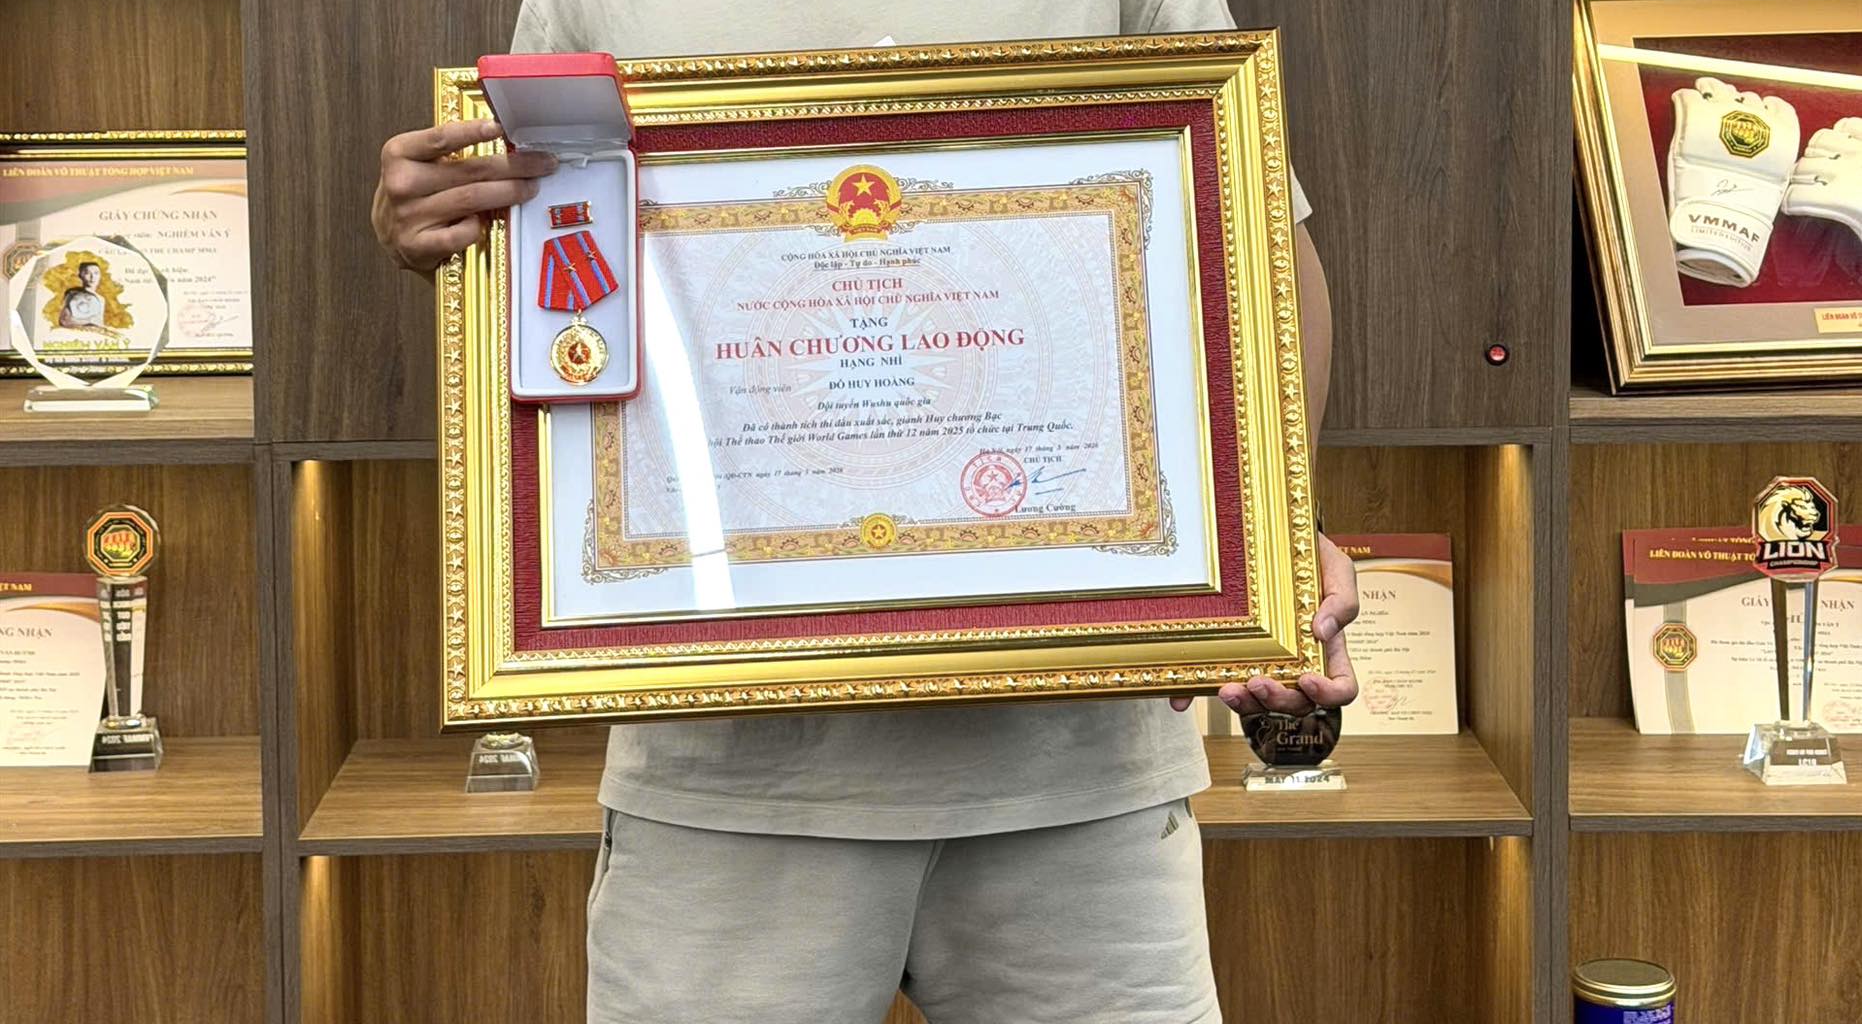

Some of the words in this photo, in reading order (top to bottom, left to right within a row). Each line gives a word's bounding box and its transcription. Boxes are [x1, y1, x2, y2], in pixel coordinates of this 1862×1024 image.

[182, 209, 218, 221] NHẬN
[1688, 214, 1760, 243] VMMAF
[781, 253, 806, 263] CỘNG
[808, 251, 826, 261] HÒA
[828, 250, 840, 260] XÃ
[842, 249, 858, 260] HỘI
[860, 247, 878, 257] CHỦ
[880, 247, 909, 257] NGHĨA
[910, 246, 930, 256] VIỆT
[931, 246, 951, 254] NAM
[814, 260, 830, 269] Độc
[831, 260, 843, 269] lập
[850, 259, 861, 269] Tự
[862, 259, 873, 267] do
[879, 258, 901, 267] Hạnh
[902, 257, 921, 266] phúc
[832, 278, 863, 292] CHỦ
[867, 277, 903, 293] TỊCH
[737, 299, 770, 311] NƯỚC
[773, 299, 806, 311] CỘNG
[808, 298, 833, 308] HÒA
[835, 295, 851, 306] XÃ
[854, 295, 875, 307] HỘI
[878, 293, 902, 304] CHỦ
[905, 292, 942, 303] NGHĨA
[944, 291, 971, 304] VIỆT
[975, 290, 999, 300] NAM
[716, 339, 782, 360] HUÂN
[790, 334, 894, 355] CHƯƠNG
[902, 332, 950, 351] LAO
[956, 328, 1025, 353] ĐỘNG
[840, 357, 875, 370] HẠNG
[729, 386, 747, 395] Vận
[749, 385, 771, 395] động
[773, 385, 792, 393] viên
[848, 378, 871, 390] HUY
[874, 377, 915, 388] HOÀNG
[818, 401, 833, 411] Đội
[862, 399, 892, 408] Wushu
[894, 398, 915, 408] quốc
[917, 397, 931, 407] gia
[743, 423, 756, 432] Đã
[758, 423, 769, 431] có
[771, 421, 798, 431] thành
[800, 421, 817, 429] tích
[820, 420, 832, 428] thi
[834, 417, 851, 427] đấu
[853, 416, 875, 426] xuất
[877, 416, 894, 426] sắc,
[896, 415, 922, 426] giành
[924, 414, 945, 425] Huy
[947, 412, 982, 424] chương
[984, 411, 1003, 422] Bạc
[745, 436, 765, 445] thao
[787, 433, 805, 445] giới
[808, 431, 834, 441] World
[837, 430, 868, 440] Games
[870, 428, 886, 439] lần
[887, 427, 903, 438] thứ
[906, 428, 916, 437] 12
[919, 427, 939, 437] năm
[942, 426, 963, 436] 2025
[965, 425, 975, 434] tổ
[977, 424, 999, 434] chức
[1001, 424, 1014, 435] tại
[1017, 422, 1044, 433] Trung
[1047, 419, 1073, 432] Quốc.
[1015, 504, 1044, 514] Lương
[1046, 503, 1076, 513] Cường
[1352, 546, 1371, 554] NAM
[1649, 548, 1671, 559] LIÊN
[1672, 549, 1697, 559] ĐOÀN
[1698, 550, 1712, 560] VÕ
[1712, 551, 1742, 562] THUẬT
[1763, 541, 1826, 560] LION
[11, 583, 32, 592] NAM
[1363, 590, 1396, 602] NHẬN
[1741, 595, 1770, 608] GIẤY
[1821, 600, 1855, 612] NHẬN
[17, 627, 52, 639] NHẬN
[1279, 719, 1297, 730] The
[1277, 731, 1323, 745] Grand
[1265, 776, 1286, 784] MAY
[1304, 775, 1330, 783] 2024
